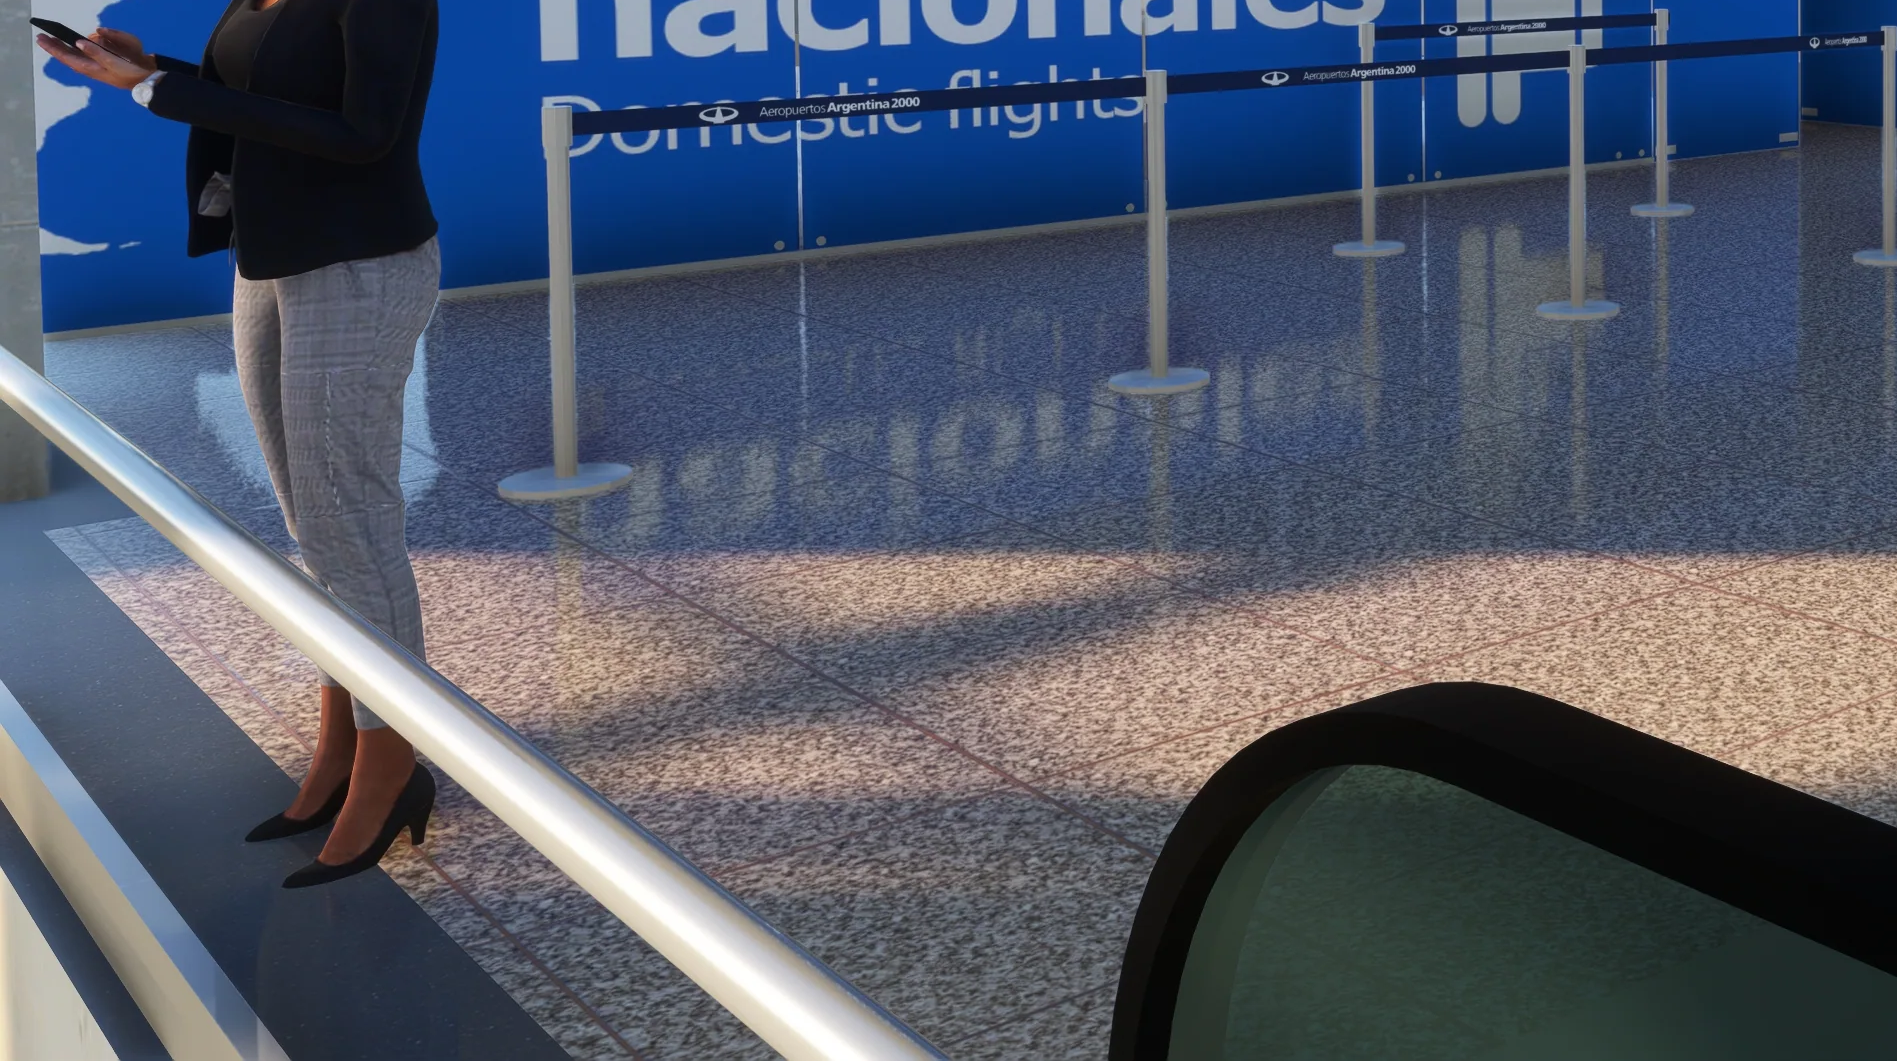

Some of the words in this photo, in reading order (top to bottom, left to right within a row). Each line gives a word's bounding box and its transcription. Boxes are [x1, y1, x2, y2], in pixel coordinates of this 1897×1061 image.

[1303, 69, 1350, 81] Aeropuertos
[1350, 66, 1395, 79] Argentina
[1395, 65, 1416, 75] 2000
[759, 104, 827, 118] Aeropuertos
[826, 99, 890, 114] Argentina
[891, 96, 921, 109] 2000
